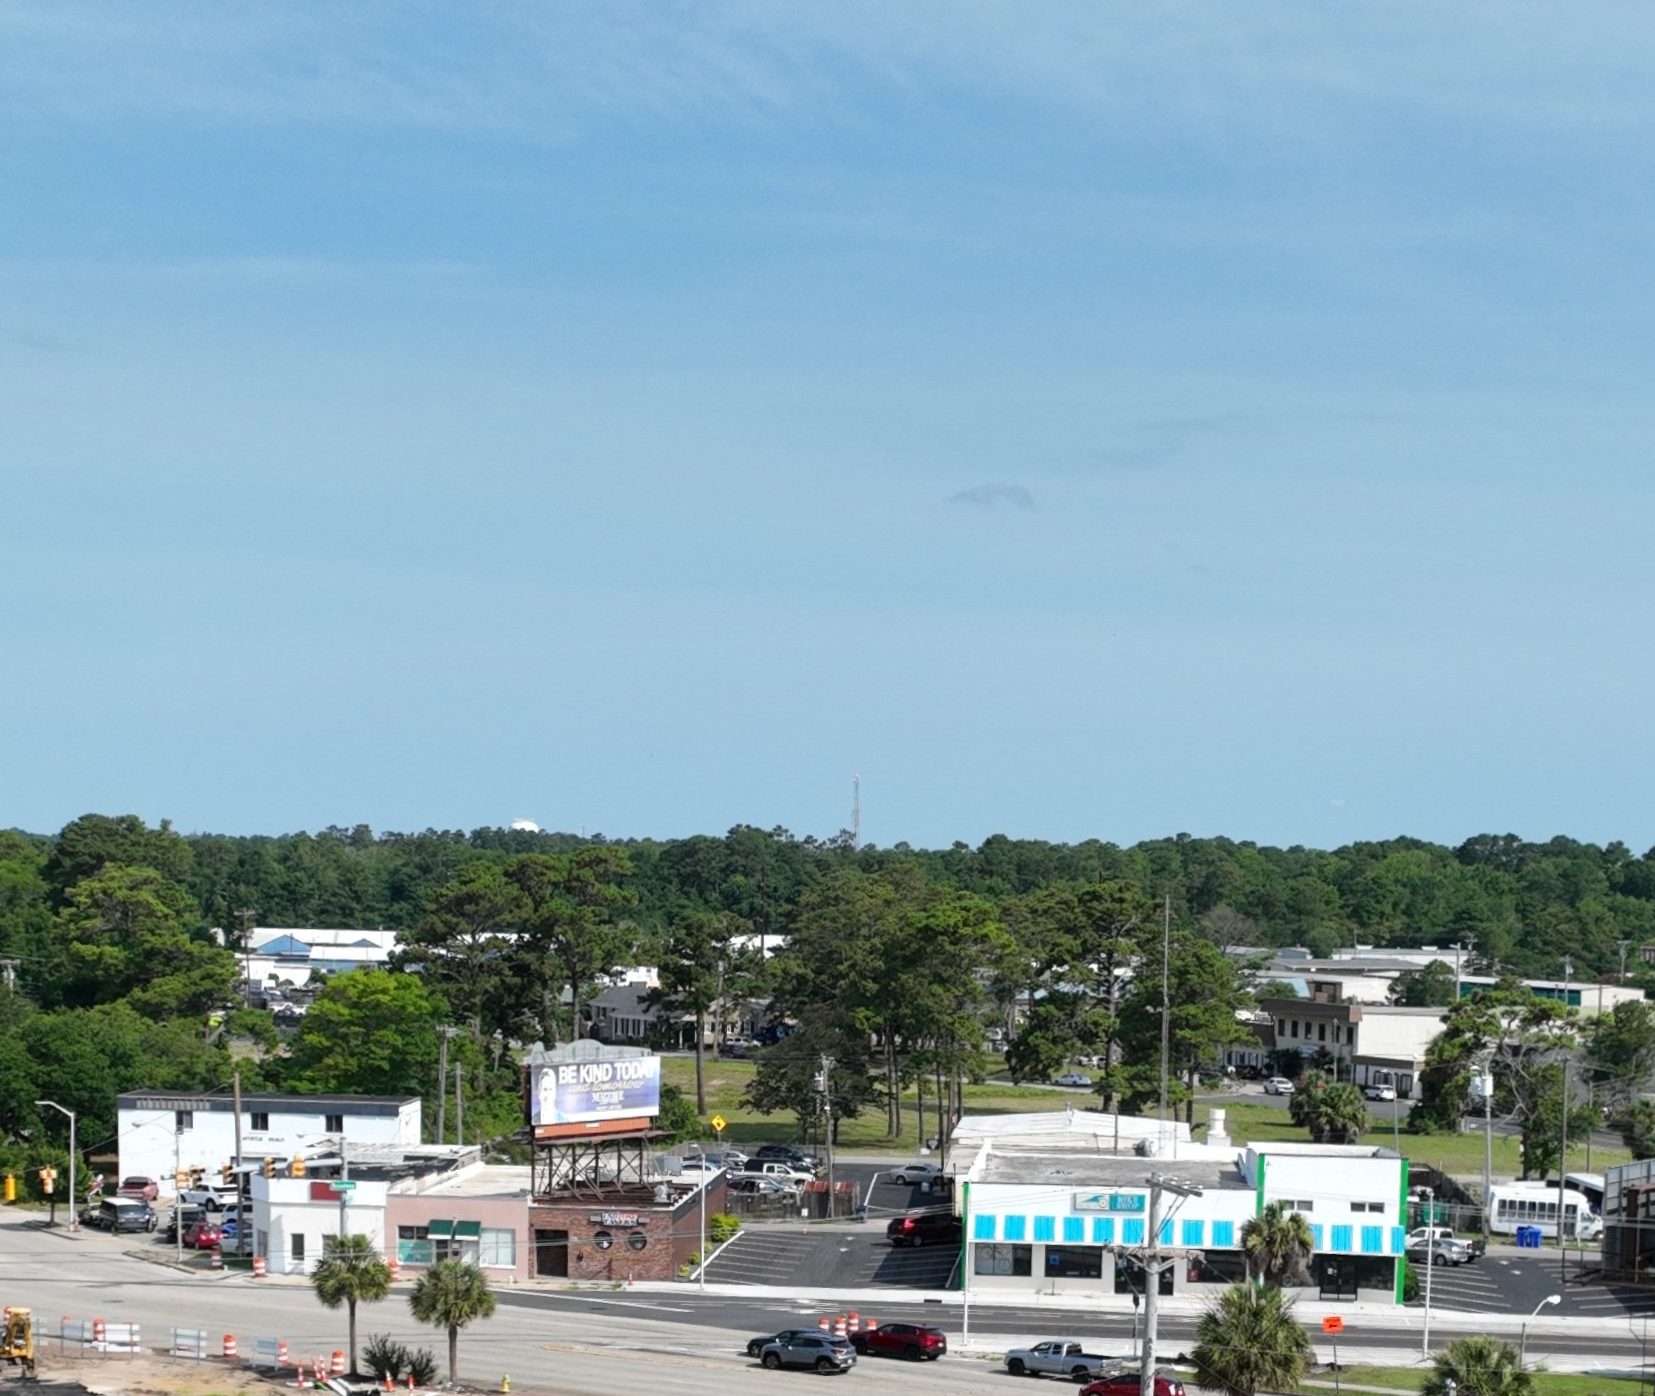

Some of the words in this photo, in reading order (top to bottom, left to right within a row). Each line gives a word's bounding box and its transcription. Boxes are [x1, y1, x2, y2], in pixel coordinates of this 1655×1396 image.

[558, 1065, 577, 1084] BE
[579, 1063, 613, 1083] KIND
[614, 1061, 655, 1080] TODAY
[593, 1080, 645, 1091] tomorrow
[1116, 1202, 1138, 1210] SHOP
